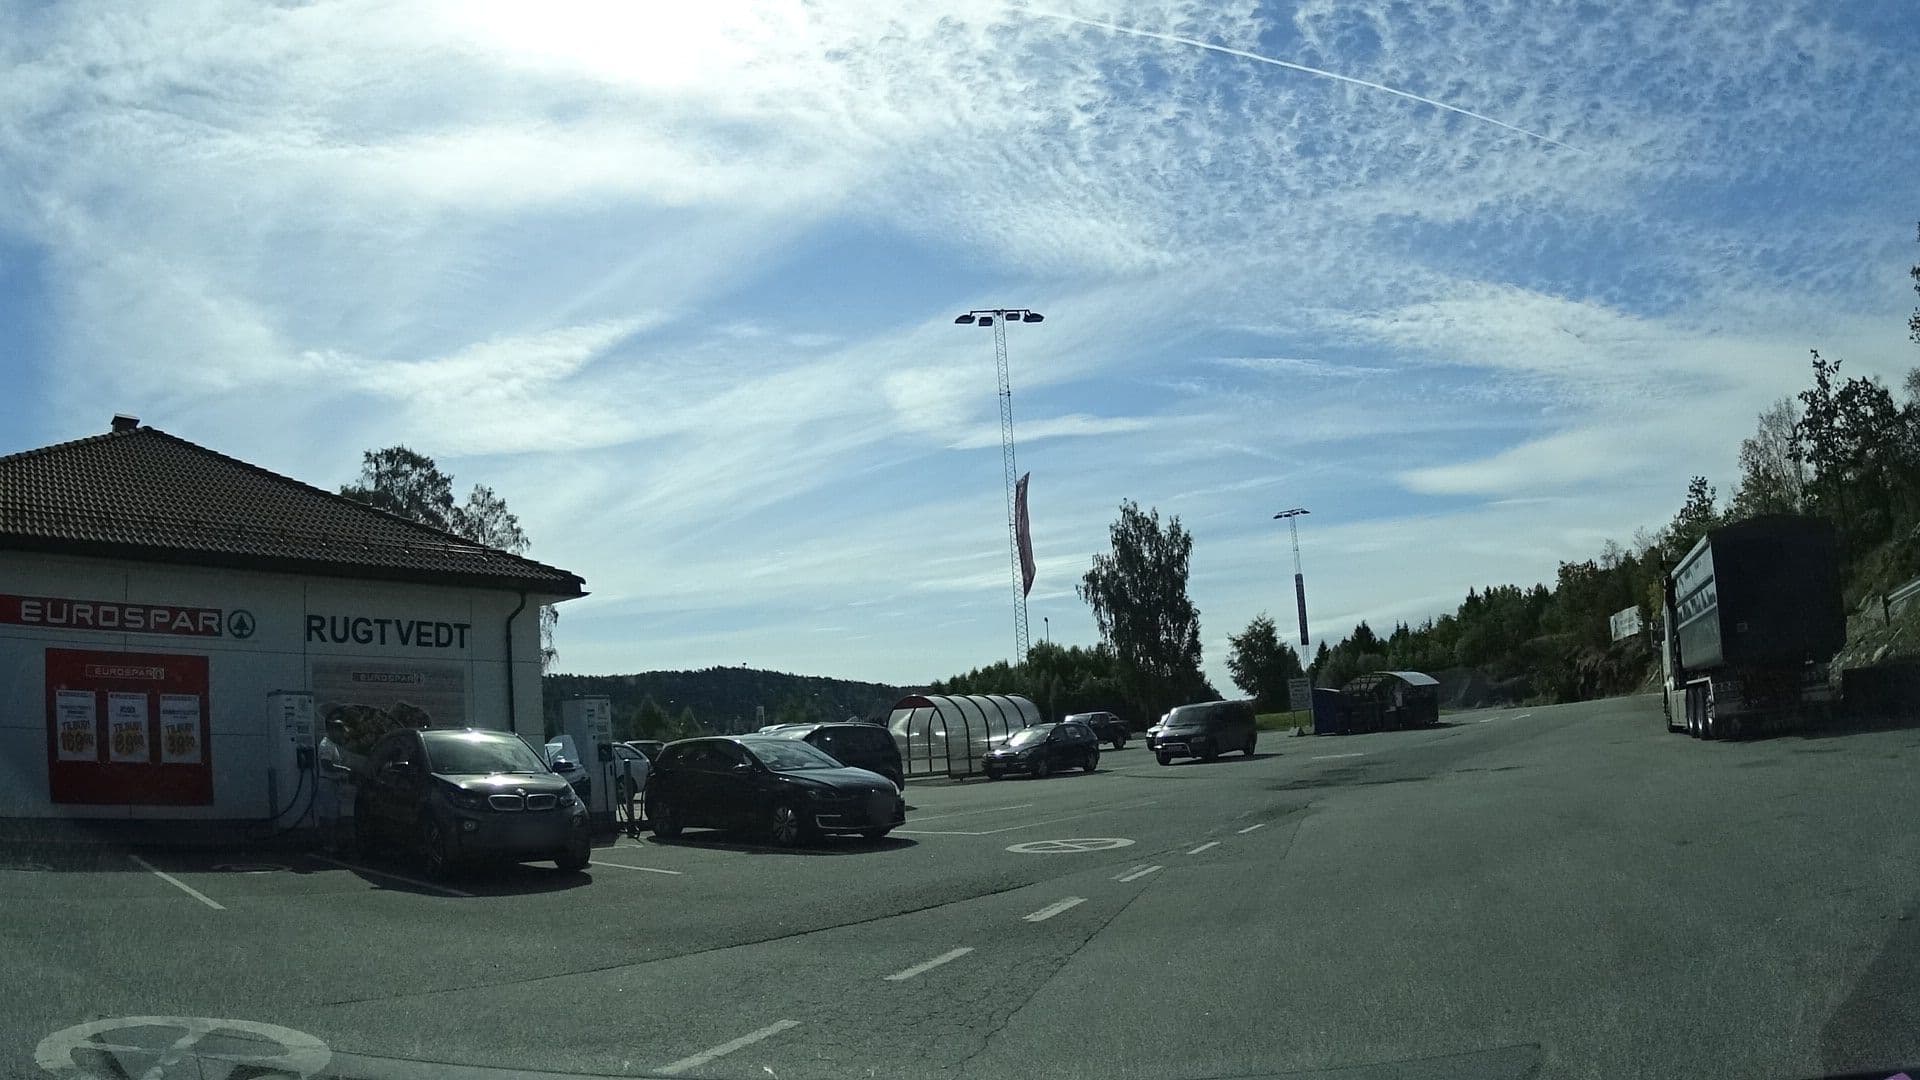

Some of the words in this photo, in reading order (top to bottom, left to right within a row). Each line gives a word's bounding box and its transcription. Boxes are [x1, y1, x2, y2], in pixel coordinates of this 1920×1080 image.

[21, 599, 220, 633] EUROSPAR
[306, 614, 471, 648] RUGTVEDT
[94, 666, 153, 679] EUROSPAR
